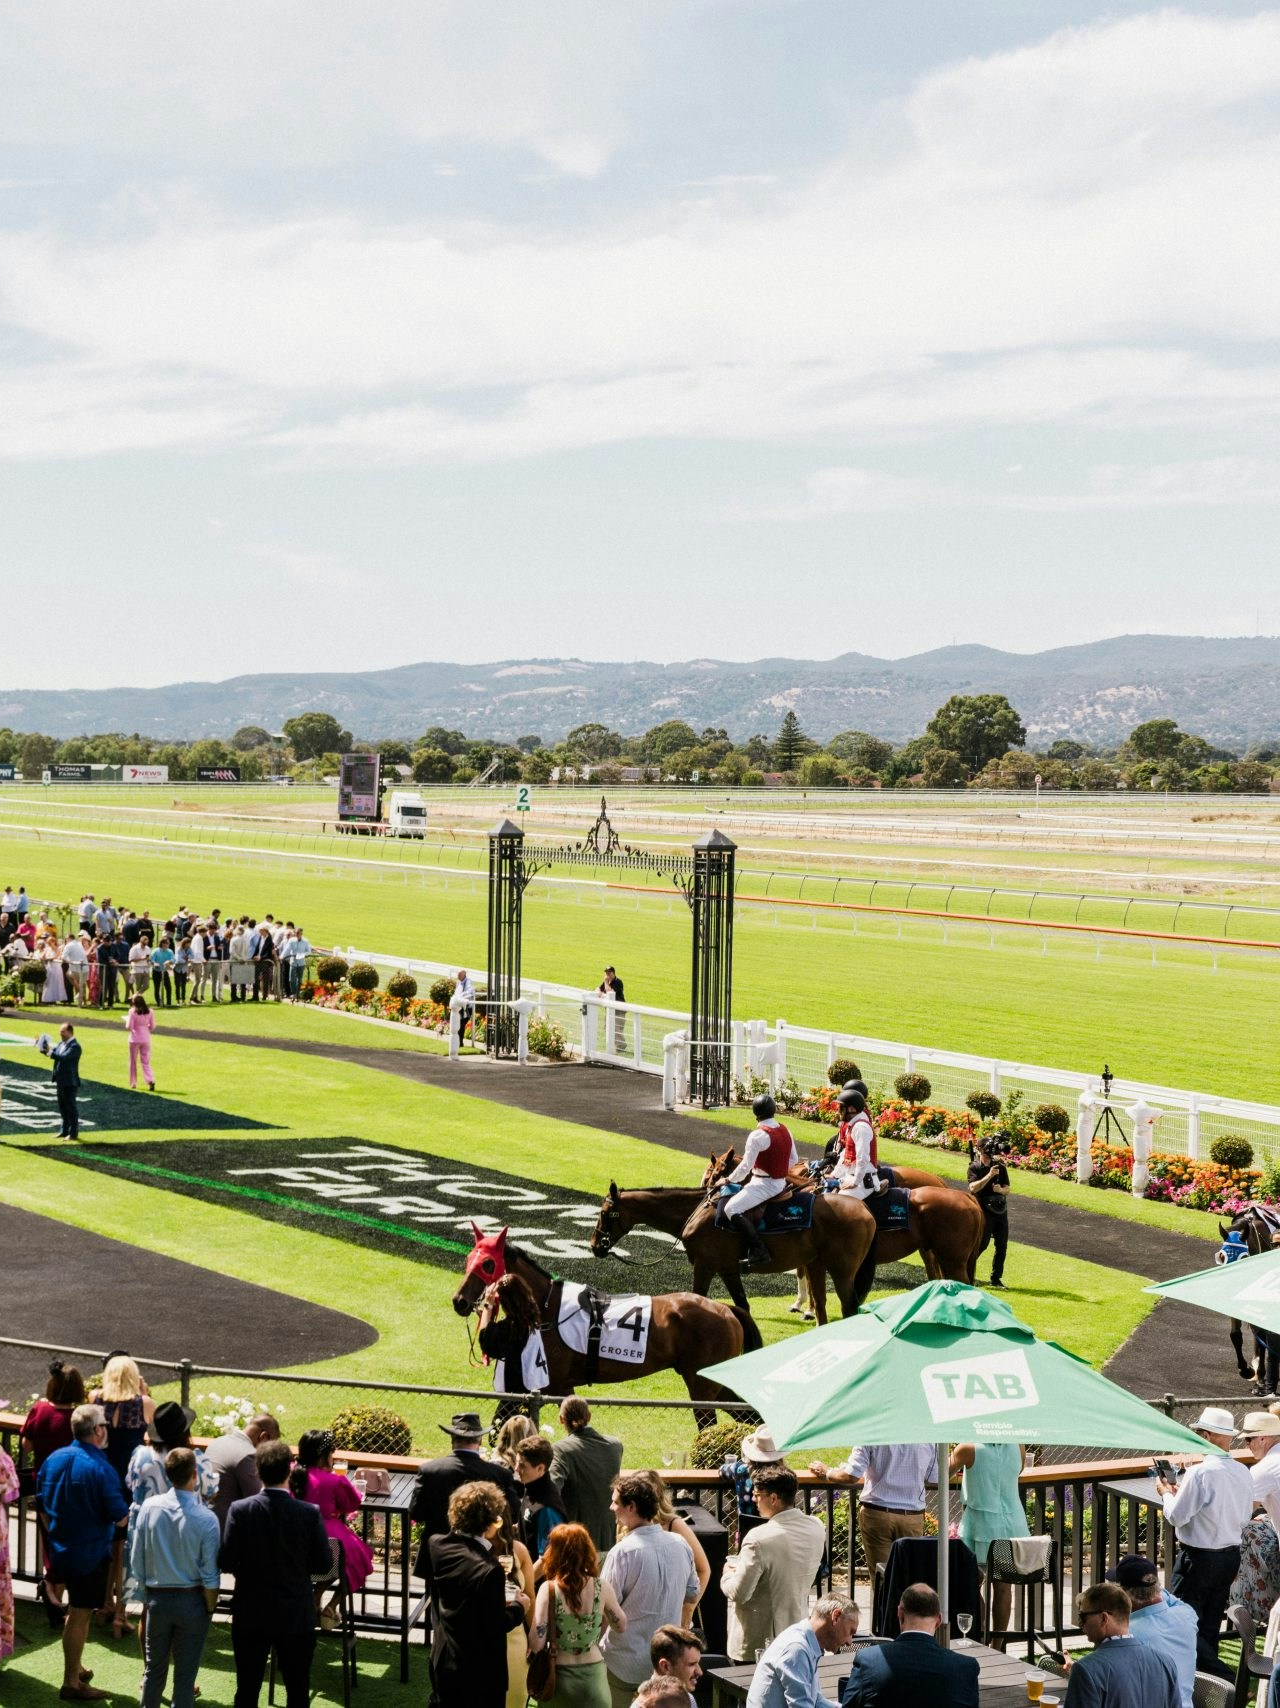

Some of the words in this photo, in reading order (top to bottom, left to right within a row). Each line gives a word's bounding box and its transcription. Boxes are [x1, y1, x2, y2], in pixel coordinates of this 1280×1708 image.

[519, 788, 528, 803] 2
[227, 1166, 632, 1260] FARMS
[617, 1306, 645, 1342] 4
[535, 1346, 548, 1375] 4
[600, 1345, 643, 1359] CROSER
[932, 1373, 1027, 1400] TAB
[973, 1421, 1013, 1430] Gamble
